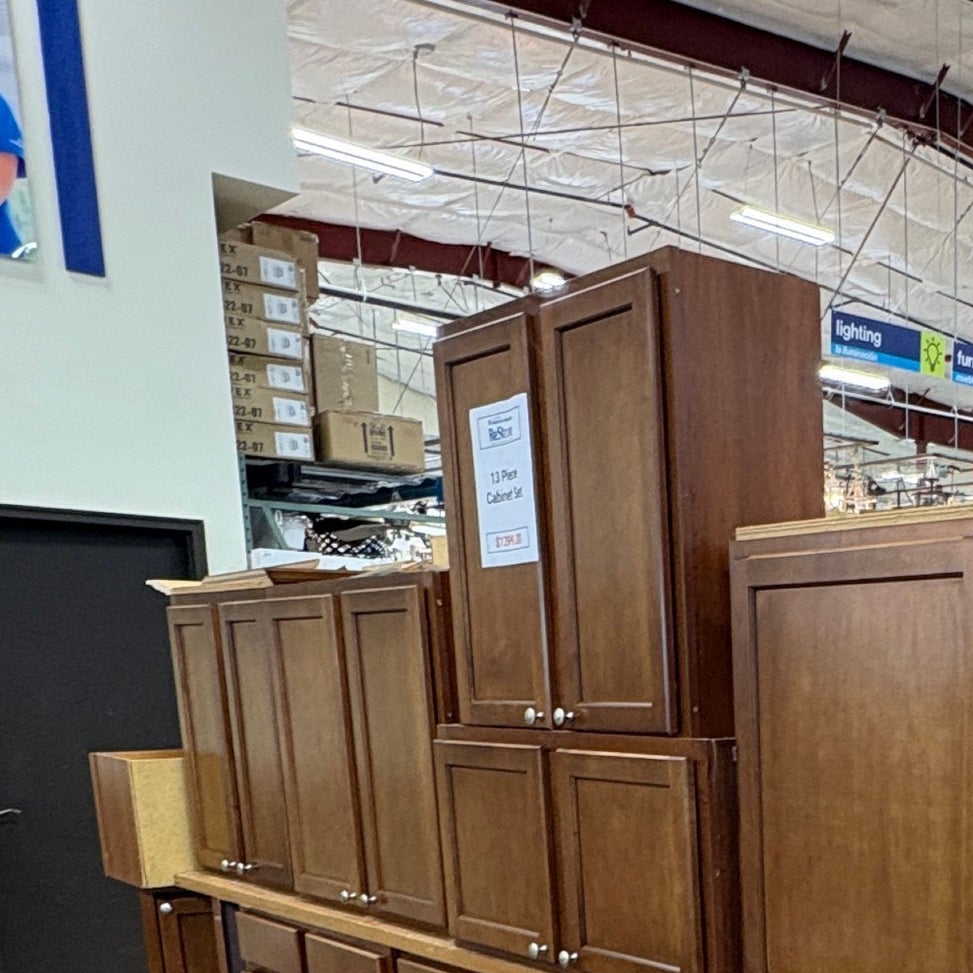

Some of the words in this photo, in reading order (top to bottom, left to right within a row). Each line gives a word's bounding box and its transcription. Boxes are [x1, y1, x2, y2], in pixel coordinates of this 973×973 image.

[835, 318, 882, 348] lighting
[490, 472, 500, 484] 13
[486, 490, 513, 505] Cabinet
